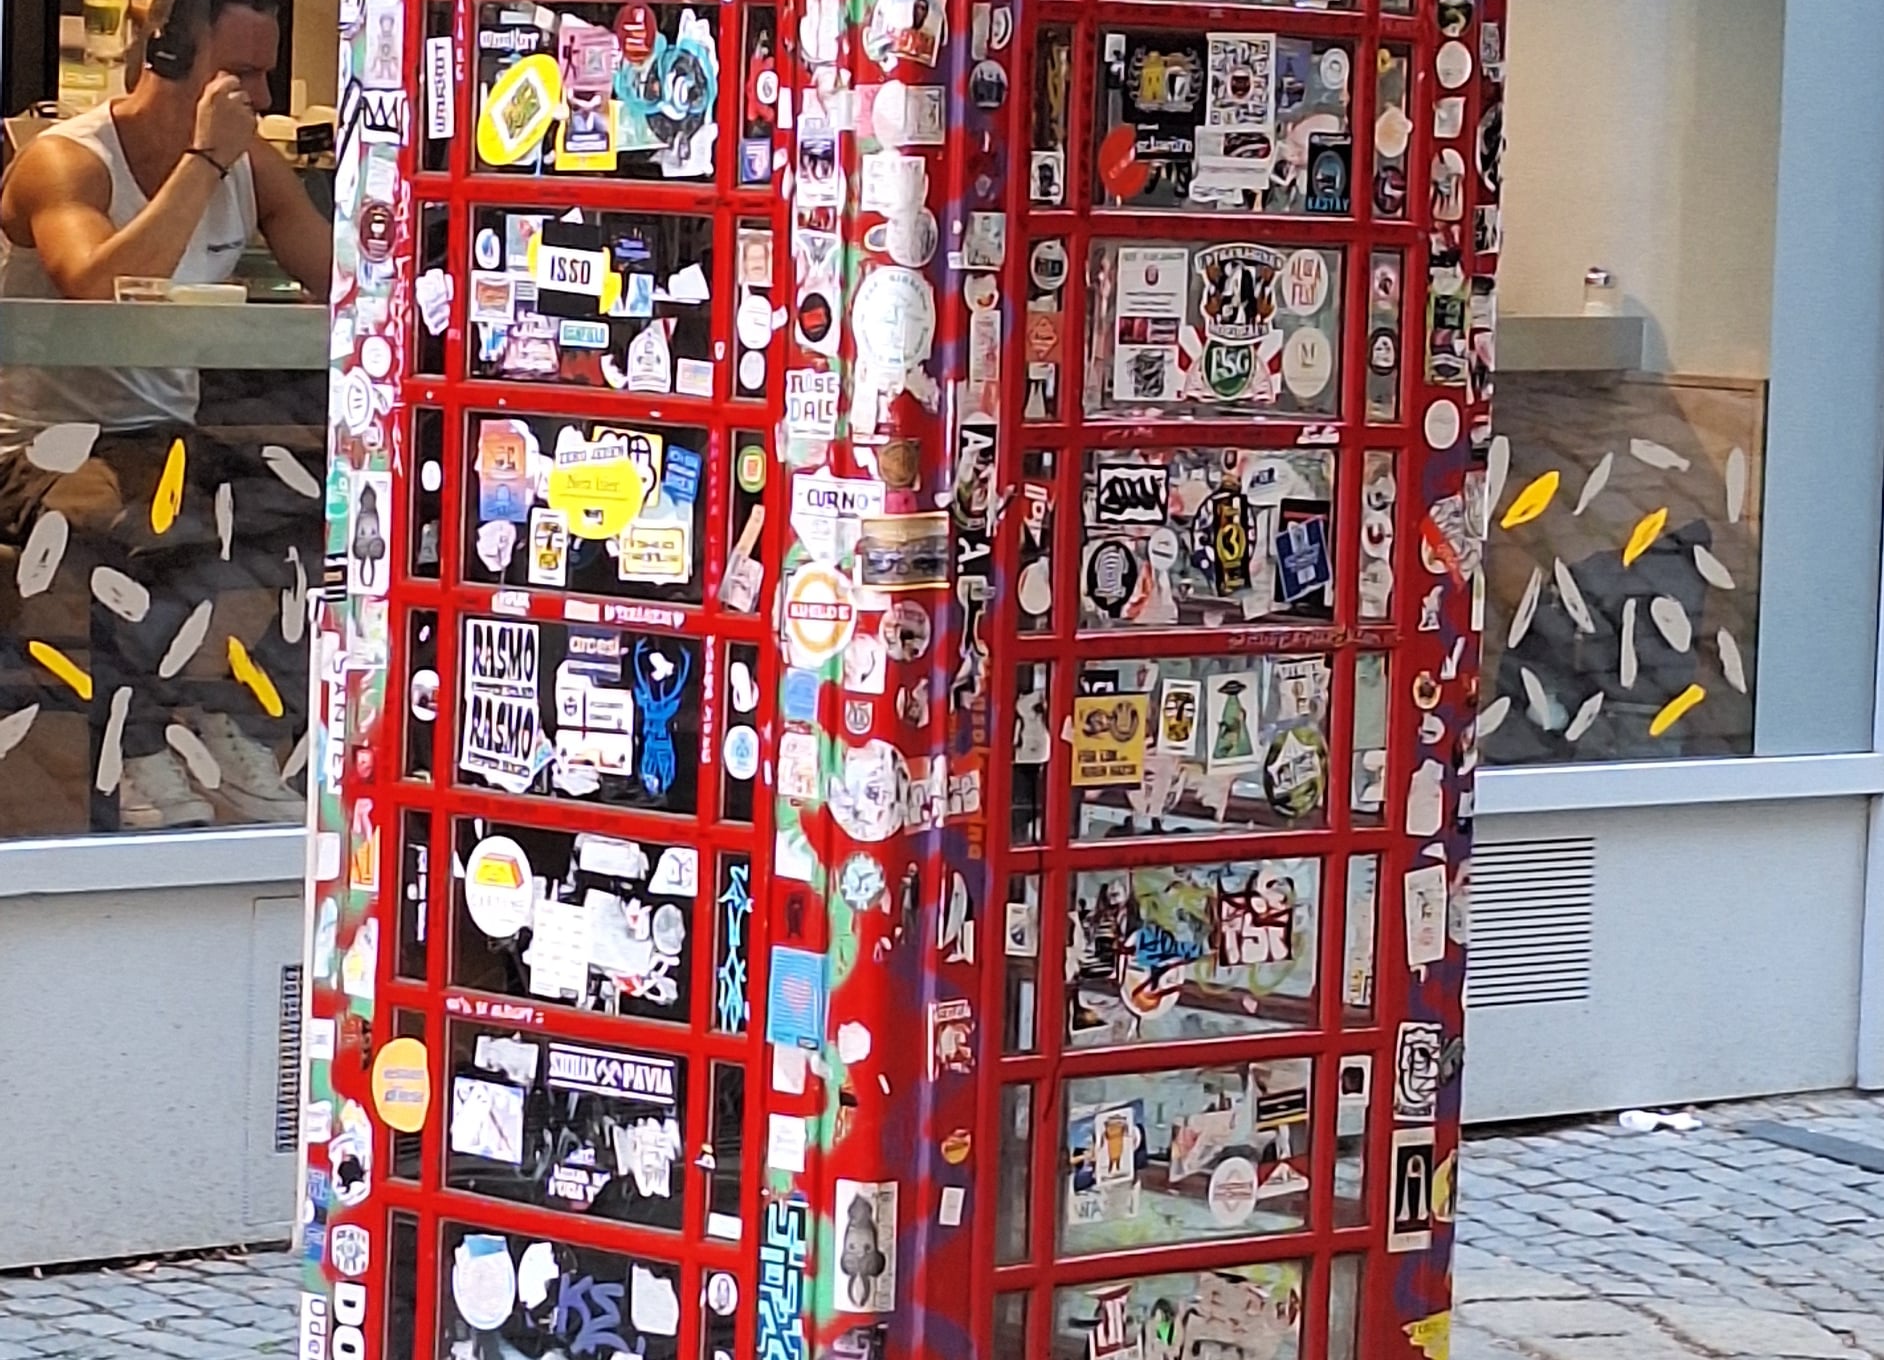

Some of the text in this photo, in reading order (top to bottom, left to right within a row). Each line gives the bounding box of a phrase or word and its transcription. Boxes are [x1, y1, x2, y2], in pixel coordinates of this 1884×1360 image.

[549, 254, 592, 285] ISSO
[472, 624, 536, 682] RASMO
[470, 695, 535, 762] RASMO
[622, 1062, 673, 1095] PAVIA
